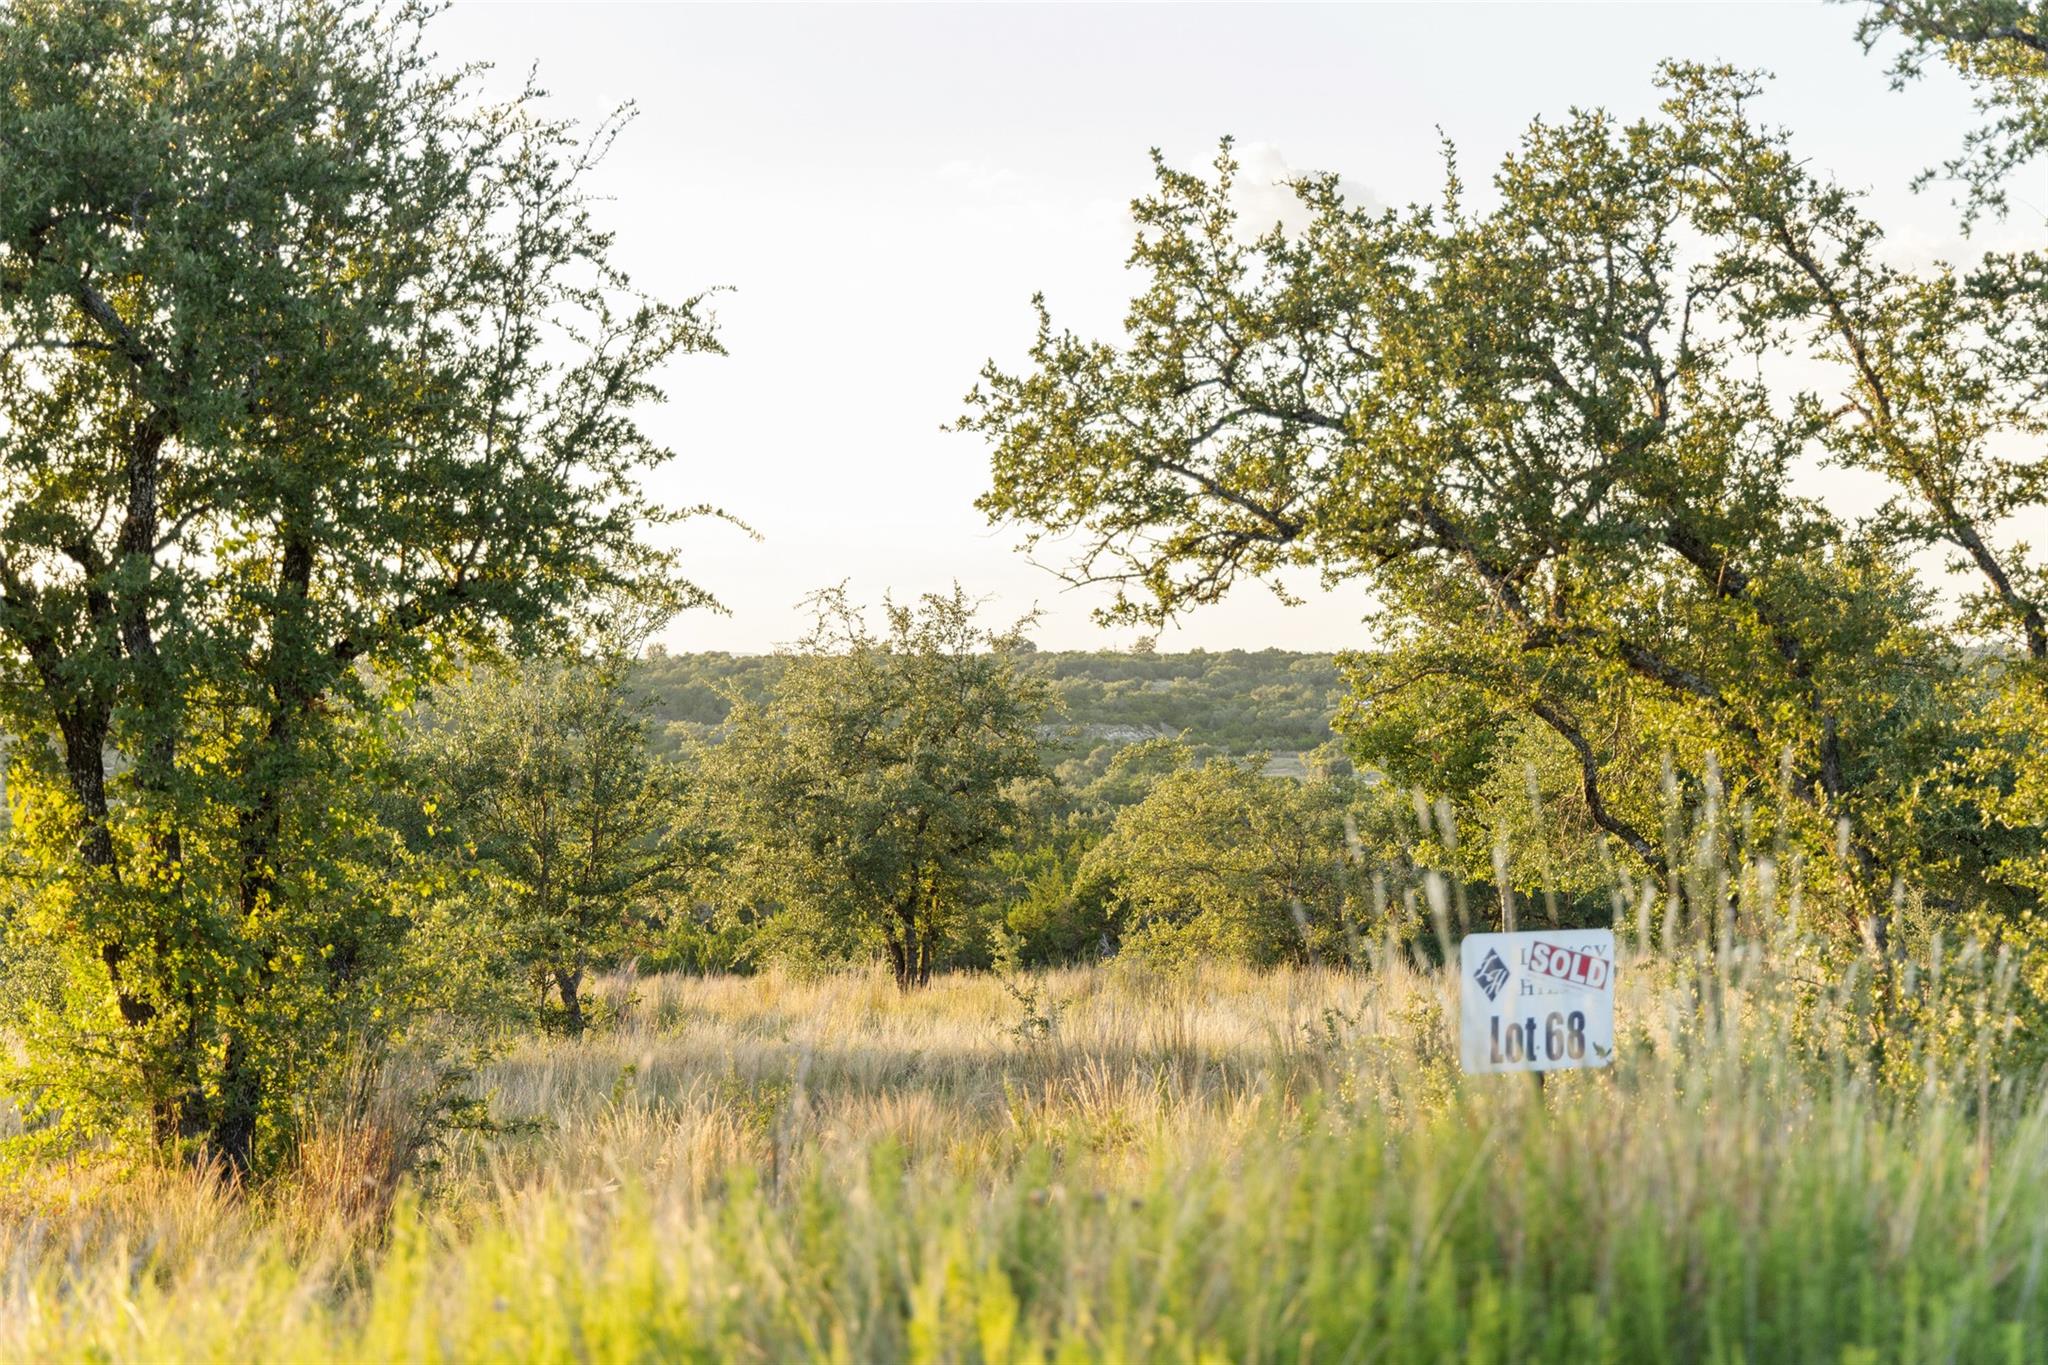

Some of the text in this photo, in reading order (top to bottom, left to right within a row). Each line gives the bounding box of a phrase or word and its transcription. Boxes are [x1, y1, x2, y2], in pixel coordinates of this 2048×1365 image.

[1530, 943, 1608, 989] SOLD
[1490, 1010, 1586, 1064] Lot 68
